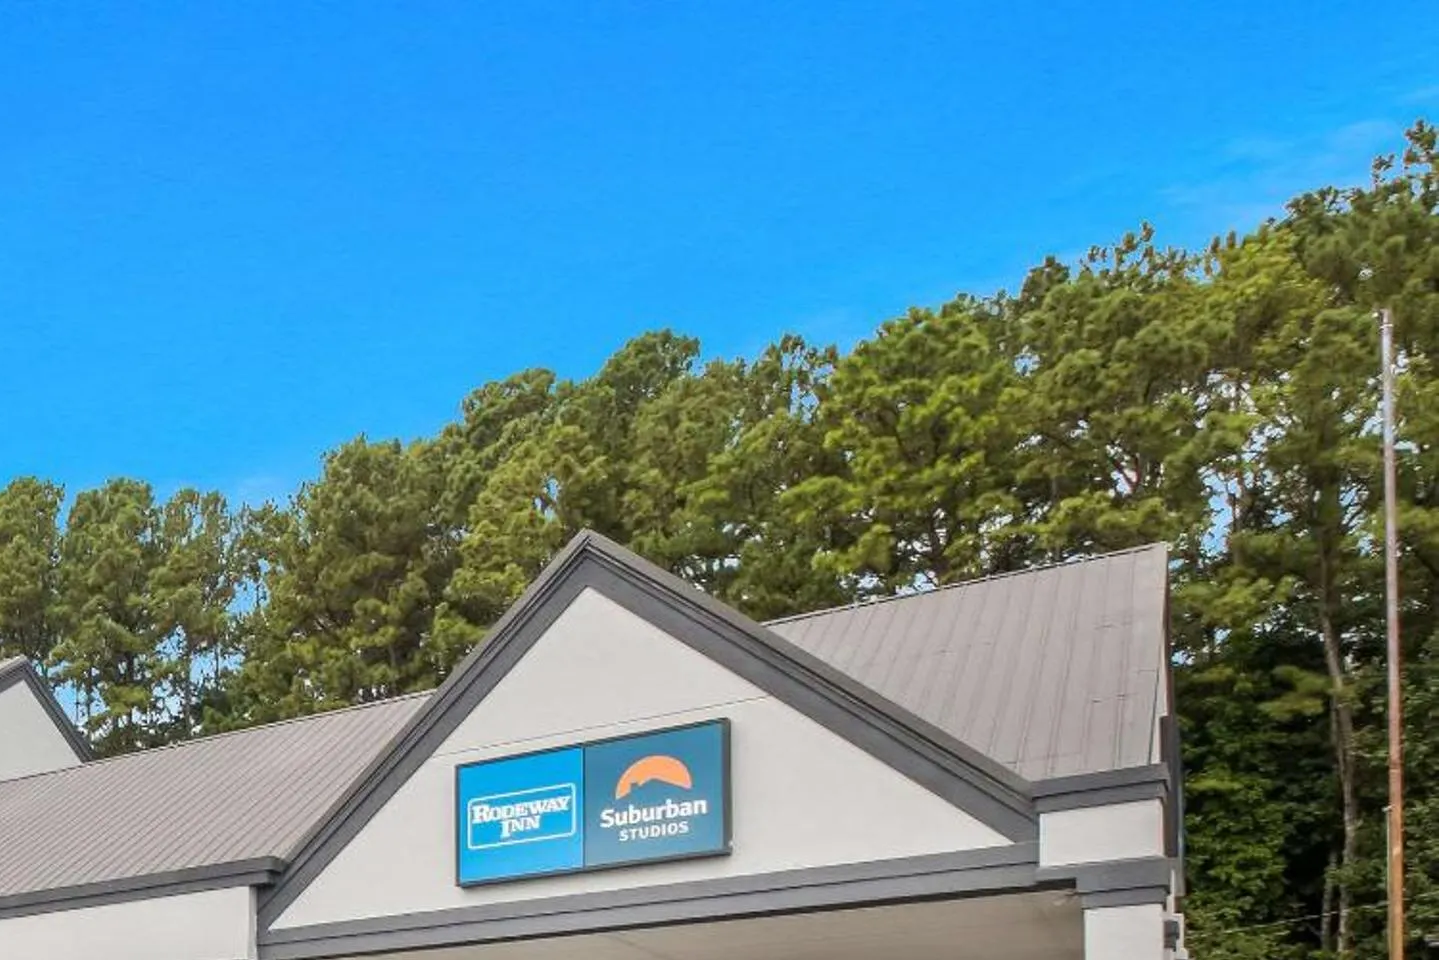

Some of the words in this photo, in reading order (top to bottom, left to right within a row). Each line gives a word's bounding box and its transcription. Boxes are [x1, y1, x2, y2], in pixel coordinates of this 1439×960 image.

[472, 796, 571, 824] RODEWAY
[600, 799, 708, 828] Suburban
[500, 815, 540, 839] INN
[619, 821, 689, 842] STUDIOS
